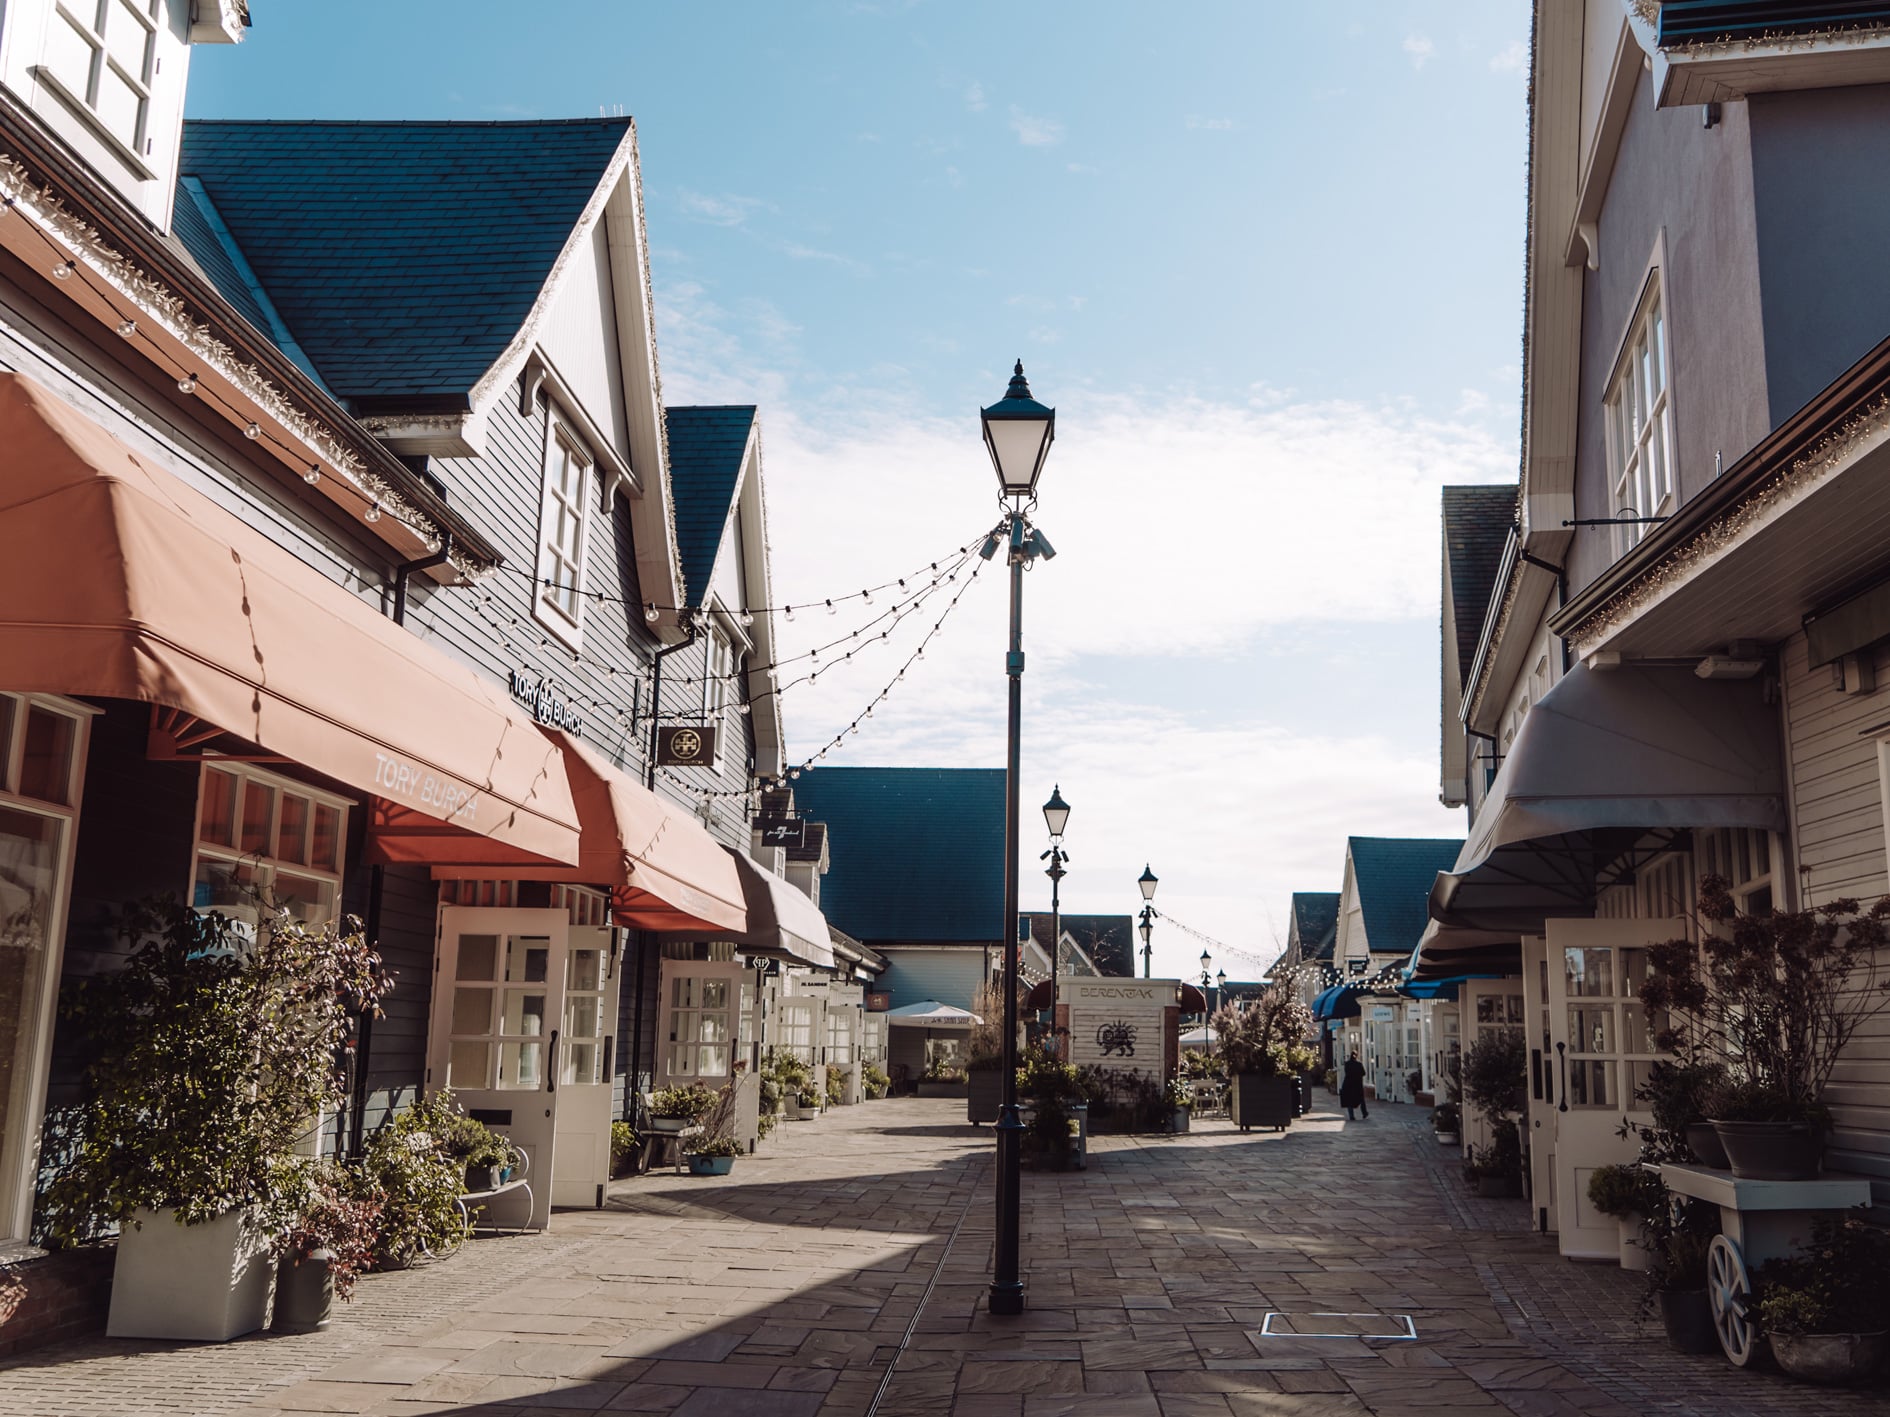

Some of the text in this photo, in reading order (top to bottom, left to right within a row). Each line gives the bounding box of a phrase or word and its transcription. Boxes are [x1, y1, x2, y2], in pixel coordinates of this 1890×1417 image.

[513, 671, 584, 737] TORY BURCH
[375, 752, 479, 820] TORY BURCH
